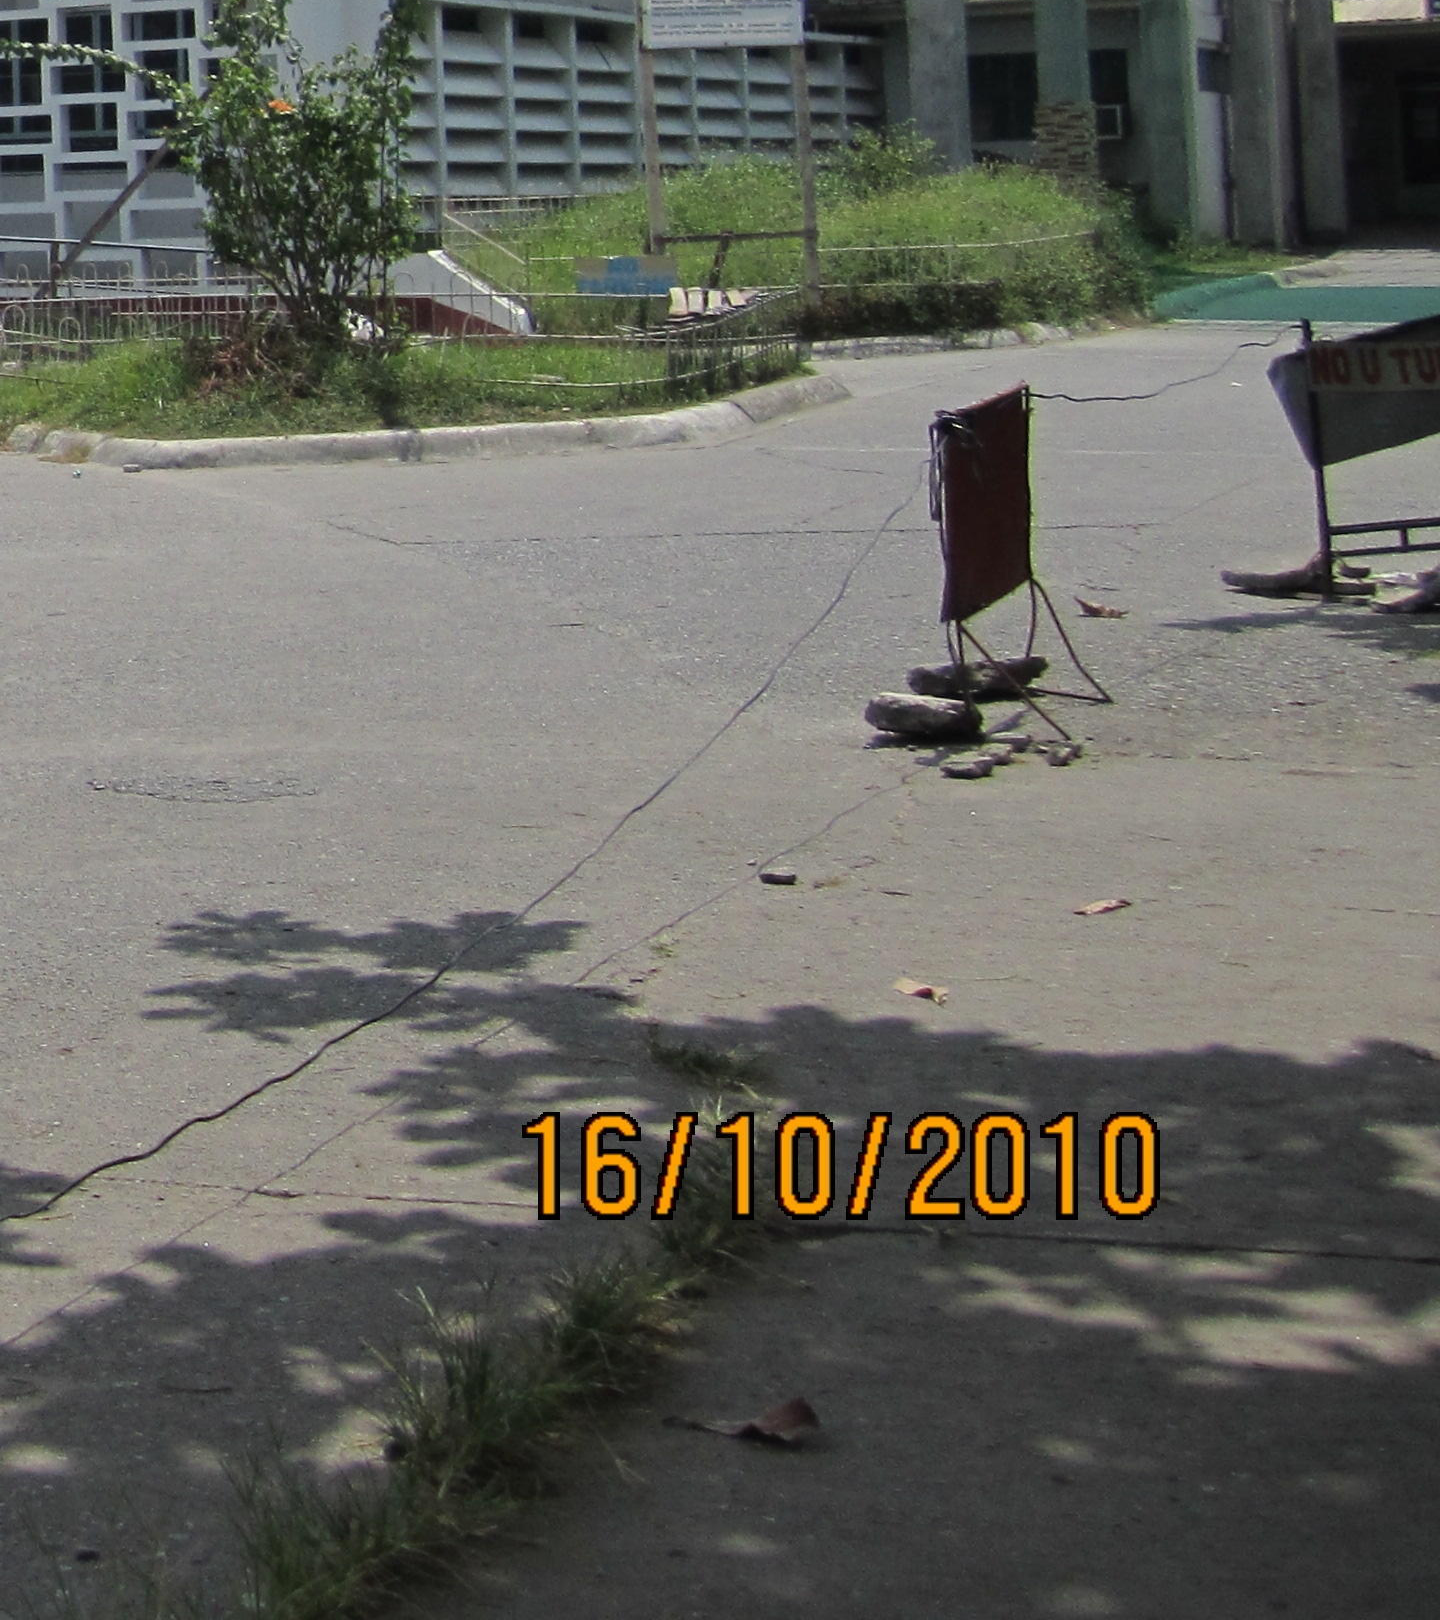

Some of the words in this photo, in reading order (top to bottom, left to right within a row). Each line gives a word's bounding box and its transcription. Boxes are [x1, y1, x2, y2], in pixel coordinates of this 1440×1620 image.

[1311, 346, 1352, 385] NO
[1359, 346, 1382, 385] U
[1388, 346, 1440, 385] TU
